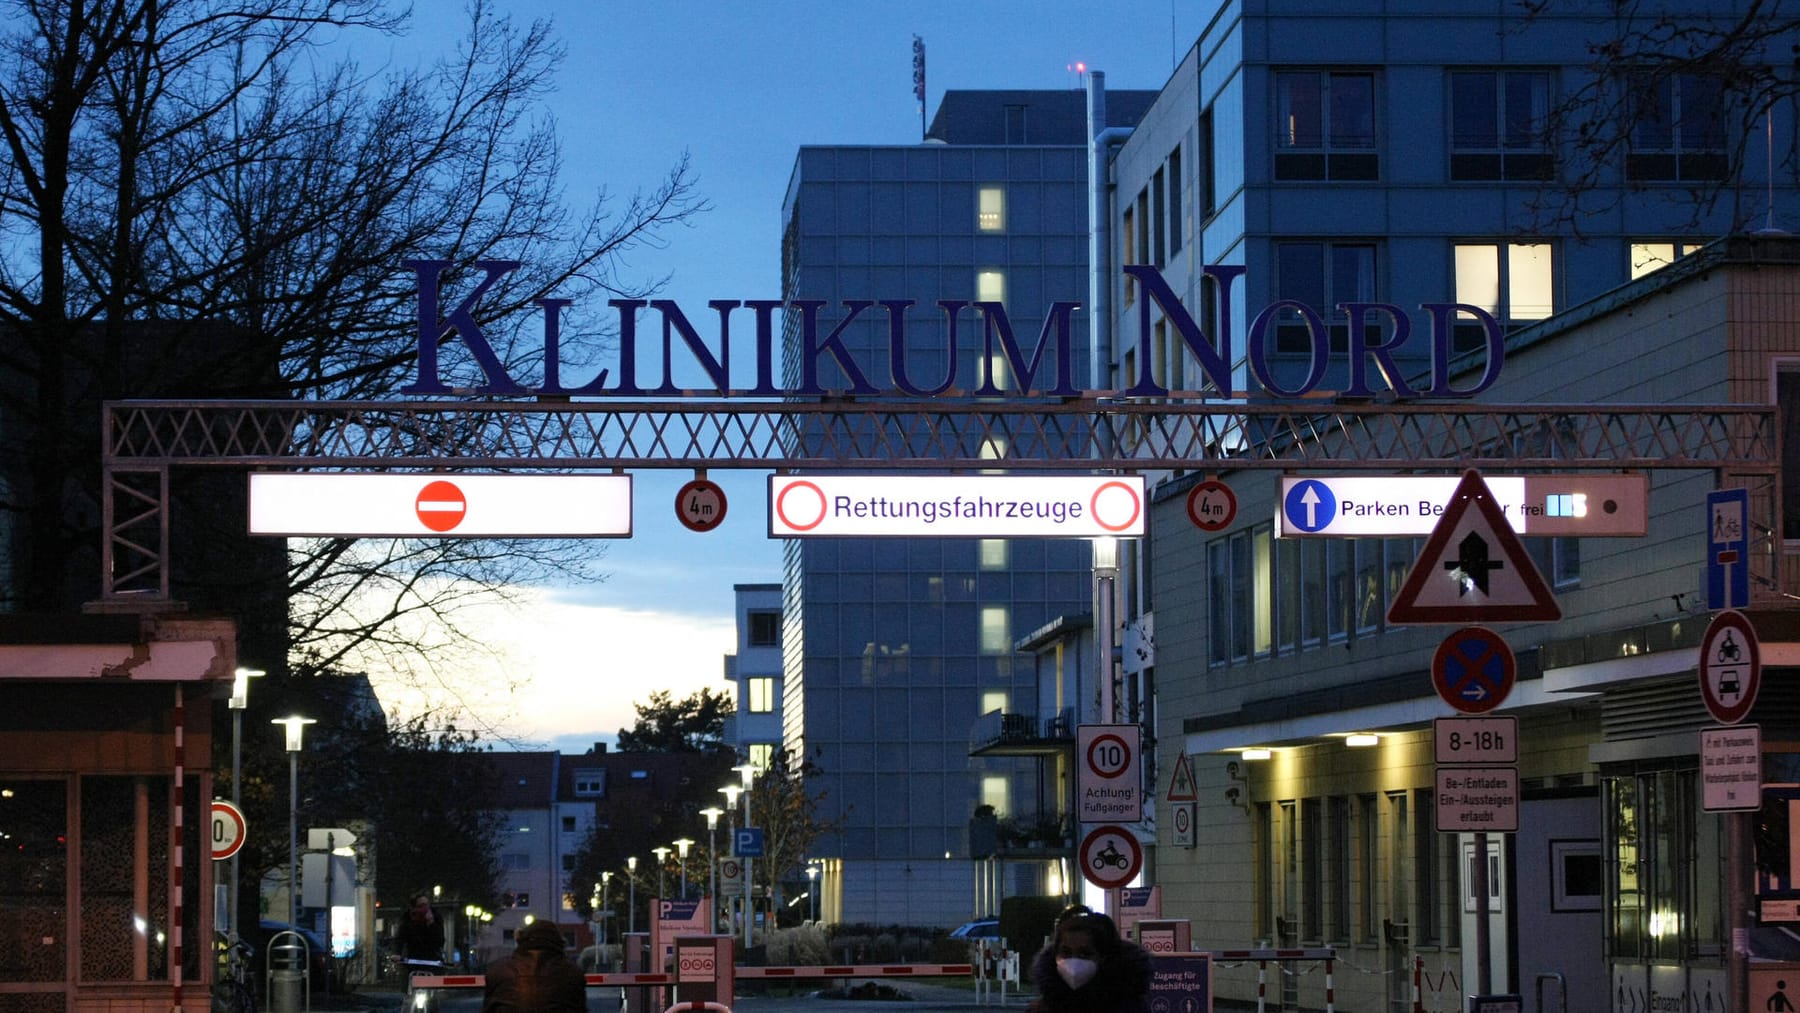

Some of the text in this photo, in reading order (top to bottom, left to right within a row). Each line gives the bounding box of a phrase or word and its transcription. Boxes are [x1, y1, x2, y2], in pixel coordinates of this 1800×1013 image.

[400, 260, 1504, 400] KLINIKUM NORD
[833, 496, 1082, 524] Rettungsfahrzeuge
[1341, 500, 1409, 516] Parken
[1521, 503, 1546, 517] frei
[1099, 746, 1121, 767] 10
[1446, 777, 1508, 789] Be-/Entladen
[1087, 787, 1134, 800] Achtung!
[1440, 794, 1514, 808] Ein-/Aussteigen
[1084, 803, 1134, 815] Fußgänger
[1460, 811, 1495, 822] erlaubt
[738, 832, 754, 854] P
[1121, 890, 1131, 905] P
[660, 901, 673, 918] P
[1153, 971, 1197, 981] Zugang für
